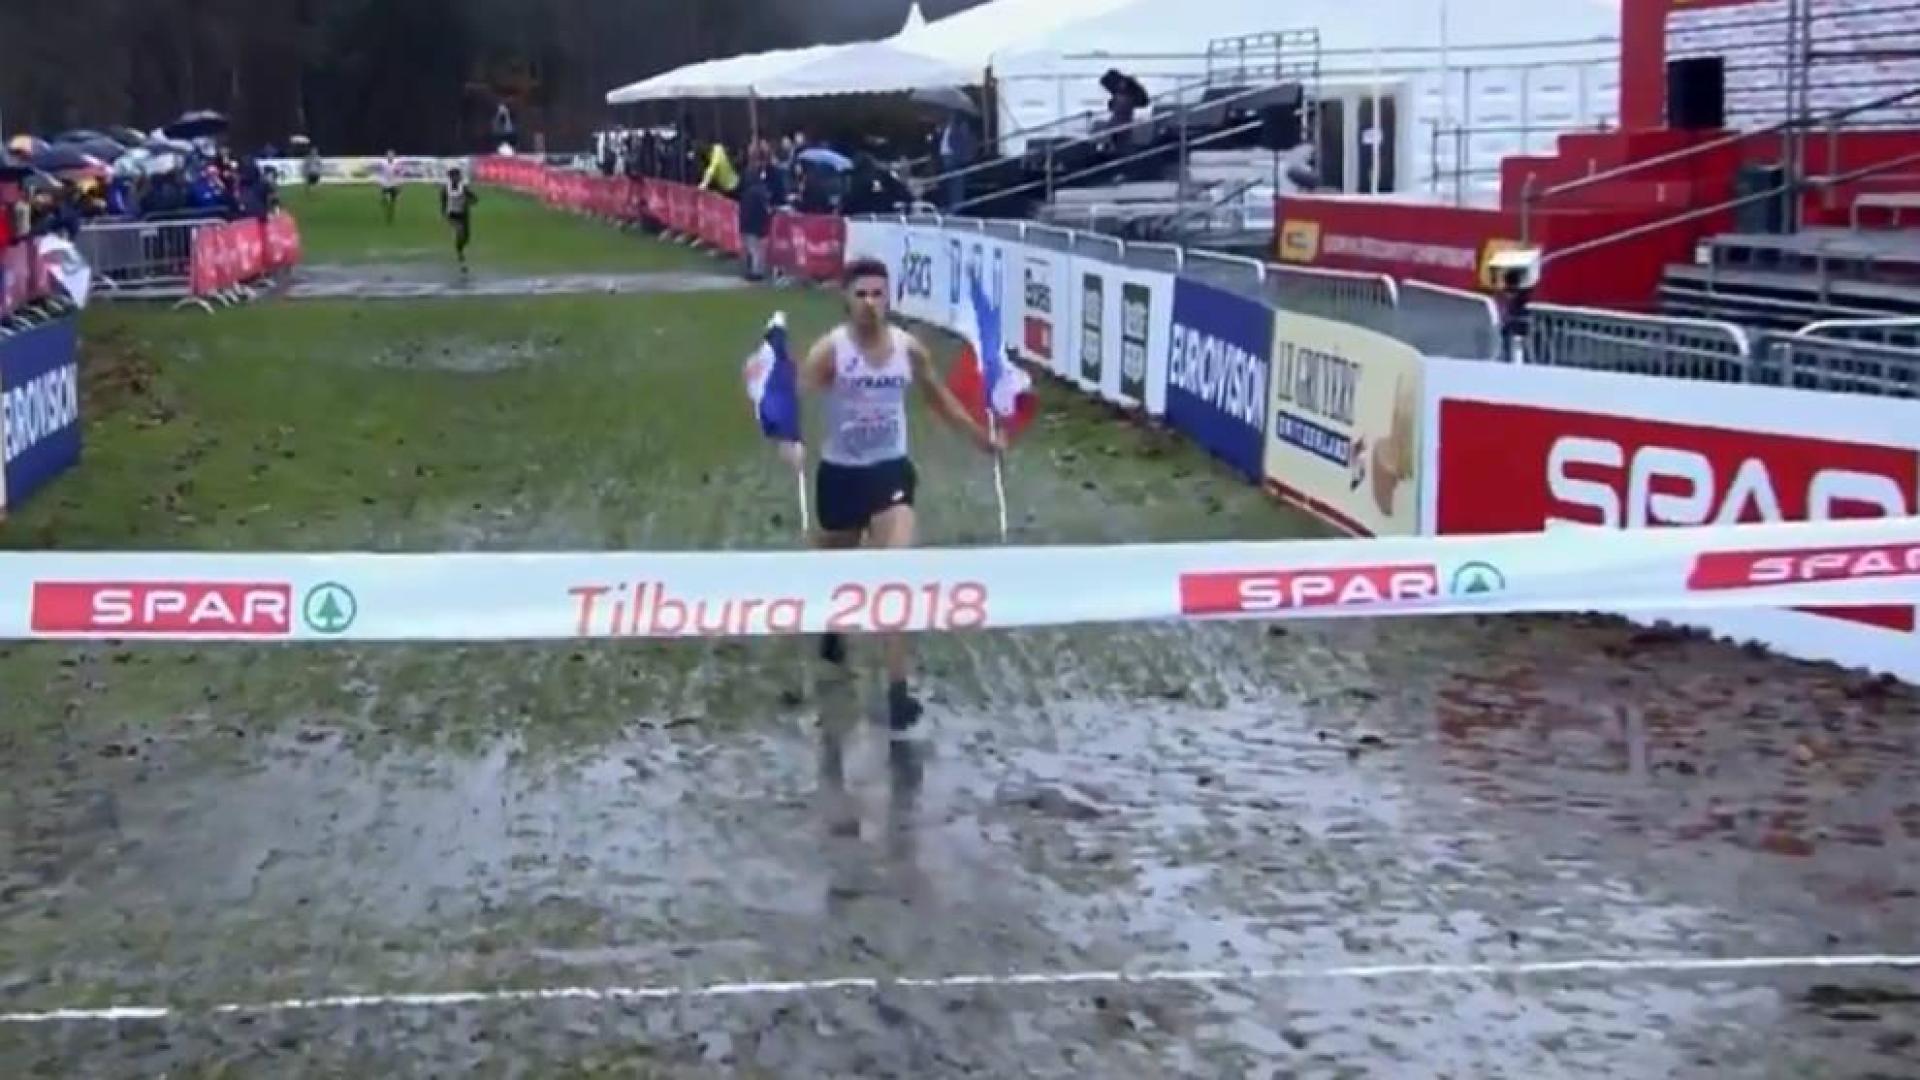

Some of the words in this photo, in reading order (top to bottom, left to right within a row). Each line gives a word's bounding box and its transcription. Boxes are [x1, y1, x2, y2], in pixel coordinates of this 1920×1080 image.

[1168, 323, 1269, 435] EUROVISION
[3, 361, 78, 462] EUROVISION
[91, 588, 287, 626] SPAR
[826, 582, 988, 631] 2018
[1238, 571, 1434, 609] SPAR
